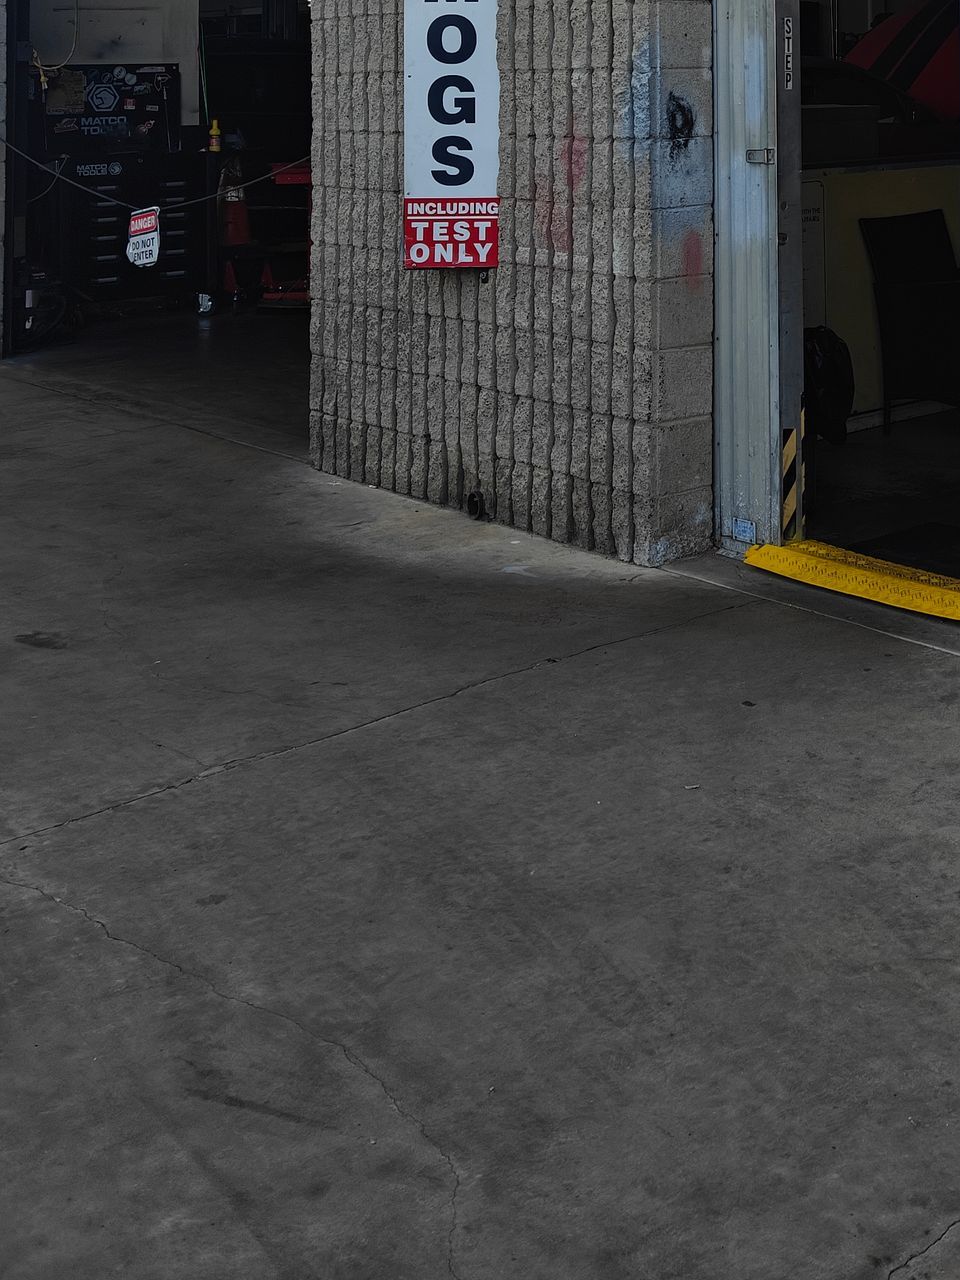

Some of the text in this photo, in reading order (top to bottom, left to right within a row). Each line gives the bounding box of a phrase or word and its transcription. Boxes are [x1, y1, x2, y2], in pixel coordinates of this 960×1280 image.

[81, 116, 127, 126] MATCO
[77, 164, 107, 172] MATCO
[407, 202, 499, 215] INCLUDING
[131, 215, 155, 231] DANGER
[411, 221, 492, 241] TEST
[132, 237, 155, 251] DO NOT
[133, 250, 153, 261] ENTER
[409, 242, 493, 263] ONLY
